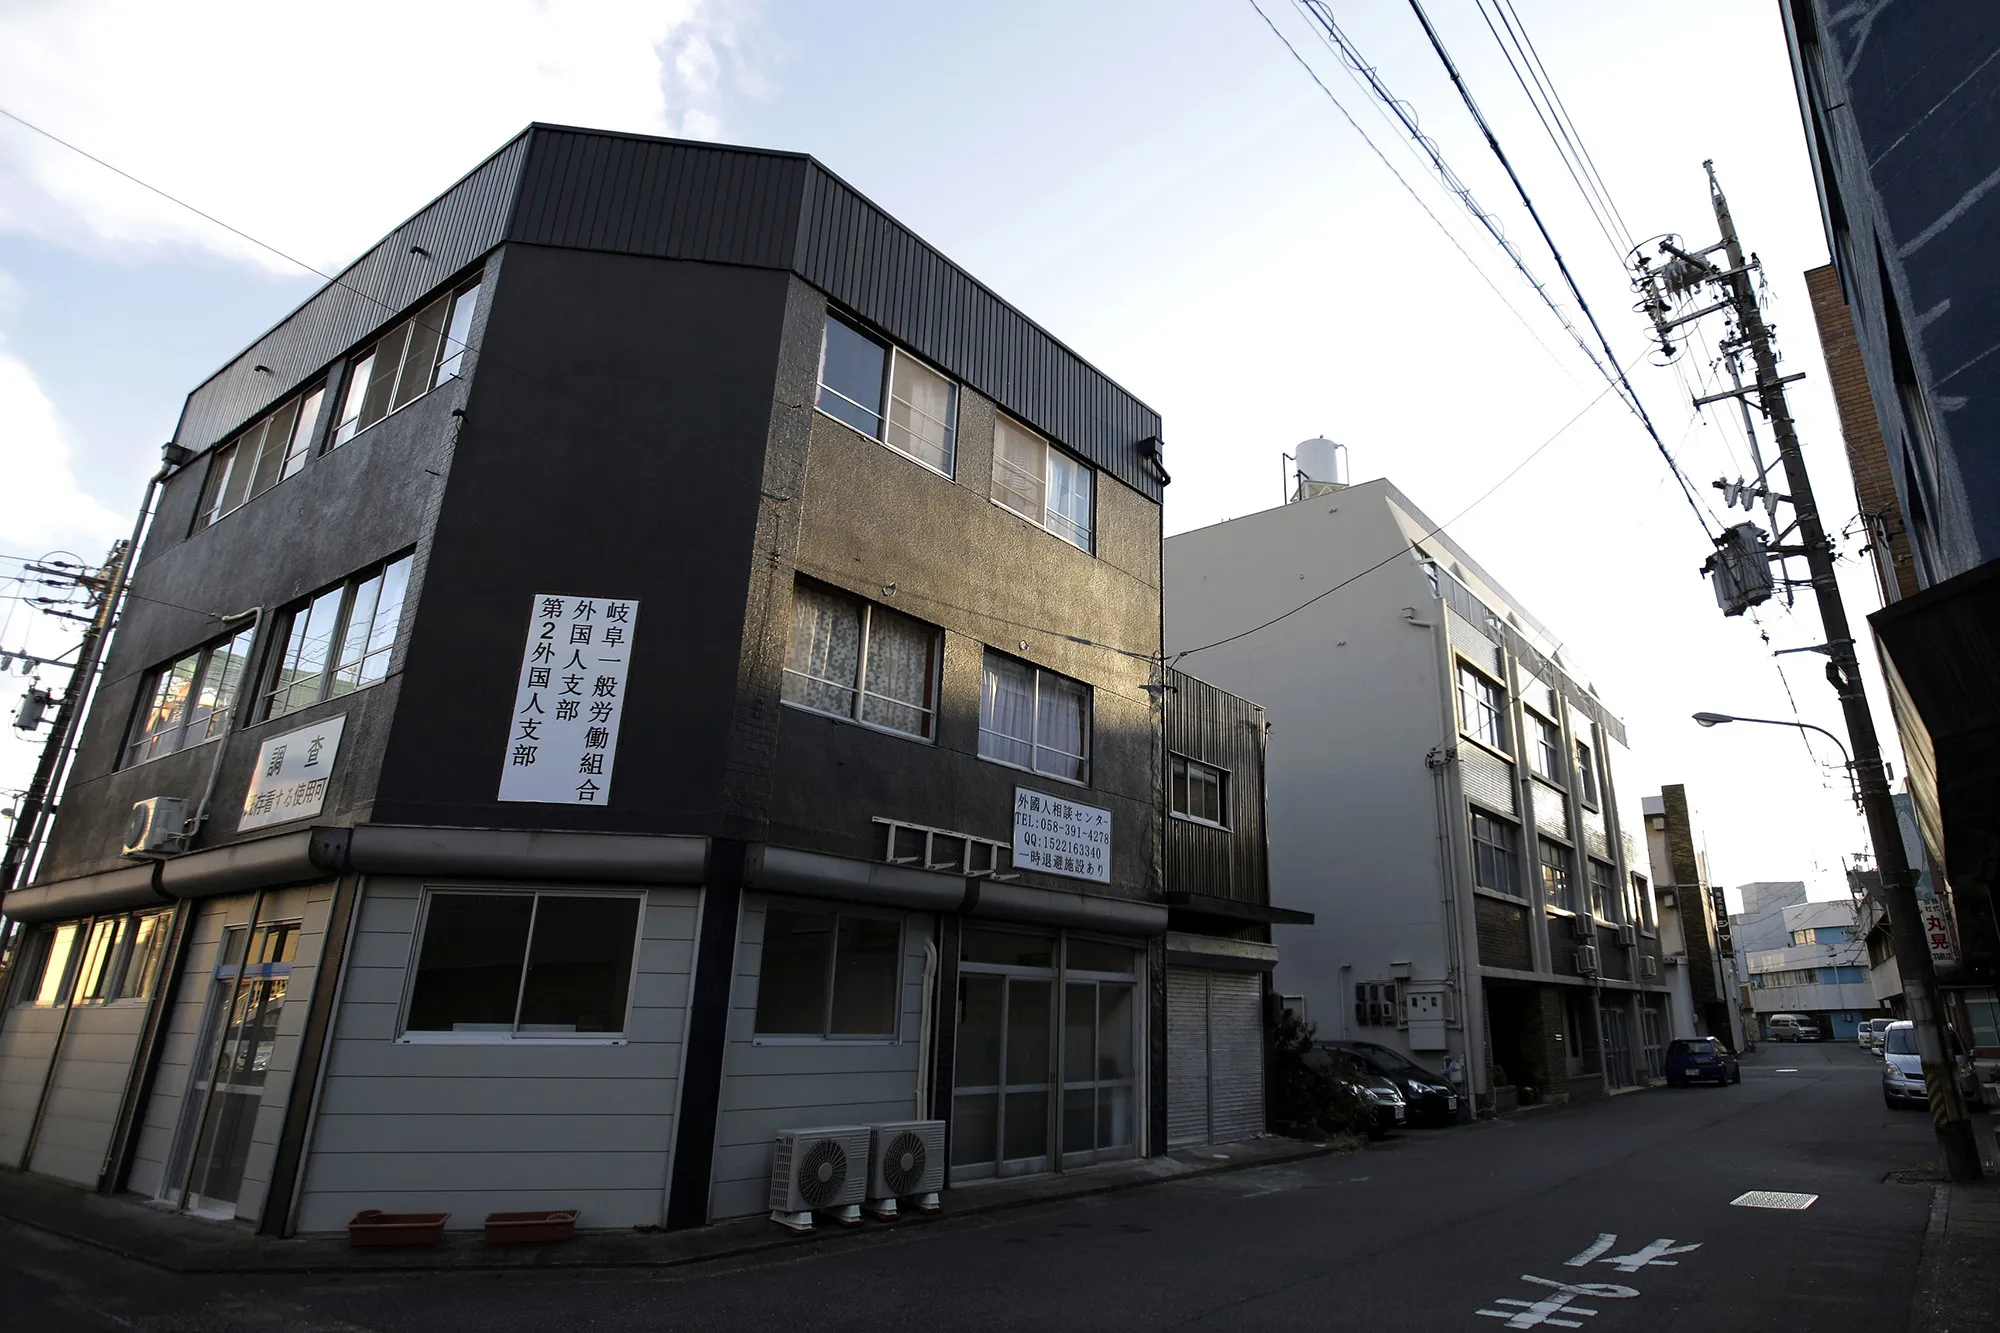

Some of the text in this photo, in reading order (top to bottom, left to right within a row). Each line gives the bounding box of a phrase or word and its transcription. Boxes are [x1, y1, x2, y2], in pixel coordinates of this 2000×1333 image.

[555, 600, 597, 722] 外国人支部
[512, 597, 565, 768] 第2外国人支部
[575, 602, 630, 802] 岐阜一般労働組合
[1015, 812, 1110, 845] TEL:058-391-4278
[1024, 831, 1101, 860] QQ:1522163340
[1018, 850, 1104, 877] 一時退避施設あり
[1926, 914, 1950, 950] 丸晃
